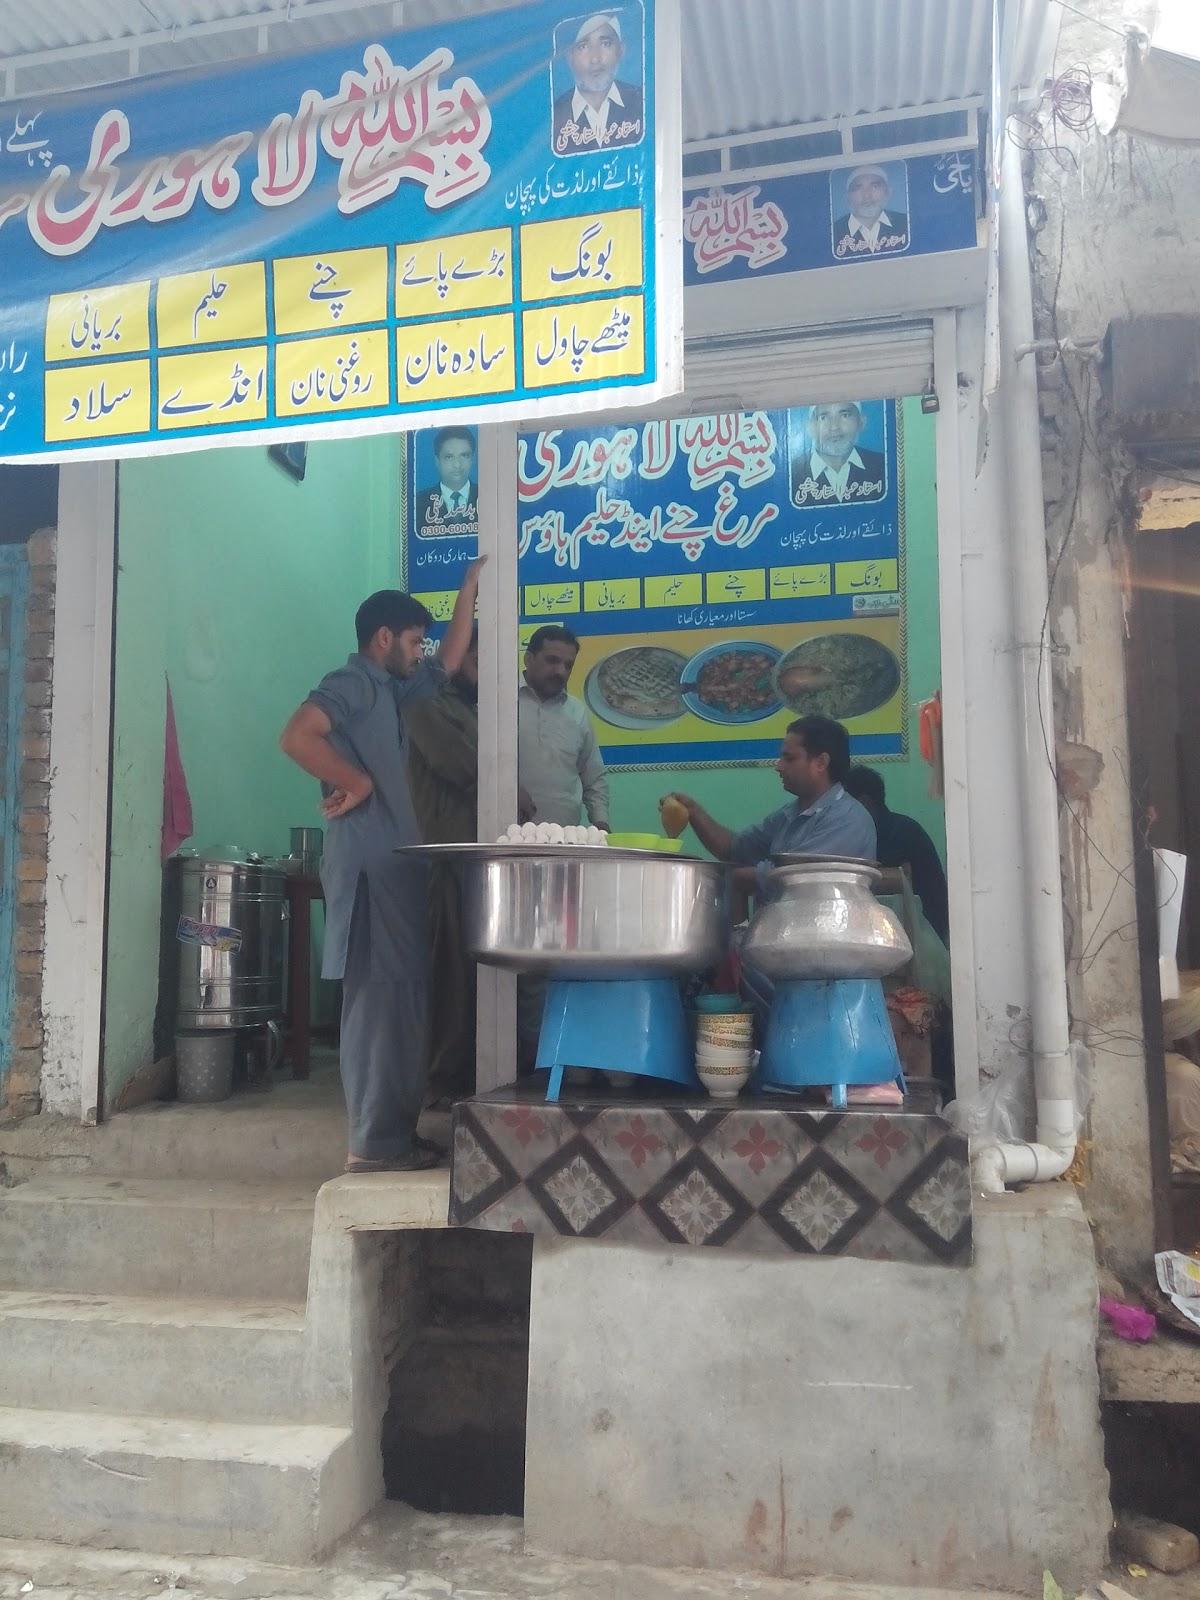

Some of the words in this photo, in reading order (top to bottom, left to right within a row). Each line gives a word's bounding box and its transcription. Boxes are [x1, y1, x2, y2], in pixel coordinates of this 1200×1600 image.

[7, 110, 53, 167] پہلے
[504, 177, 537, 216] پہچان
[538, 162, 555, 204] کی
[551, 168, 584, 198] لذت
[584, 169, 600, 193] اور
[451, 248, 505, 280] بڑے
[550, 221, 613, 282] بونگ
[193, 271, 228, 338] حلیم
[308, 261, 352, 319] چنے
[71, 294, 122, 351] بریانی
[590, 307, 631, 352] میٹھے
[406, 338, 449, 385] نان
[451, 334, 506, 374] سادہ
[536, 316, 589, 374] چاول
[161, 363, 264, 416] انڈے
[291, 368, 325, 406] نان
[328, 341, 373, 402] روغنی
[64, 381, 132, 422] سلاد
[420, 522, 479, 536] 0300-60018
[569, 487, 622, 570] حلیم
[661, 502, 716, 561] چنے
[713, 481, 779, 549] مرغ
[808, 521, 822, 545] کی
[820, 525, 849, 542] لذت
[780, 530, 807, 550] پہچان
[597, 582, 626, 608] بریانی
[663, 577, 683, 604] حلیم
[724, 574, 746, 598] چنے
[799, 572, 828, 586] بڑے
[850, 563, 882, 588] بونگ
[530, 590, 556, 610] چاول
[694, 609, 724, 626] معیاری
[724, 609, 737, 621] اور
